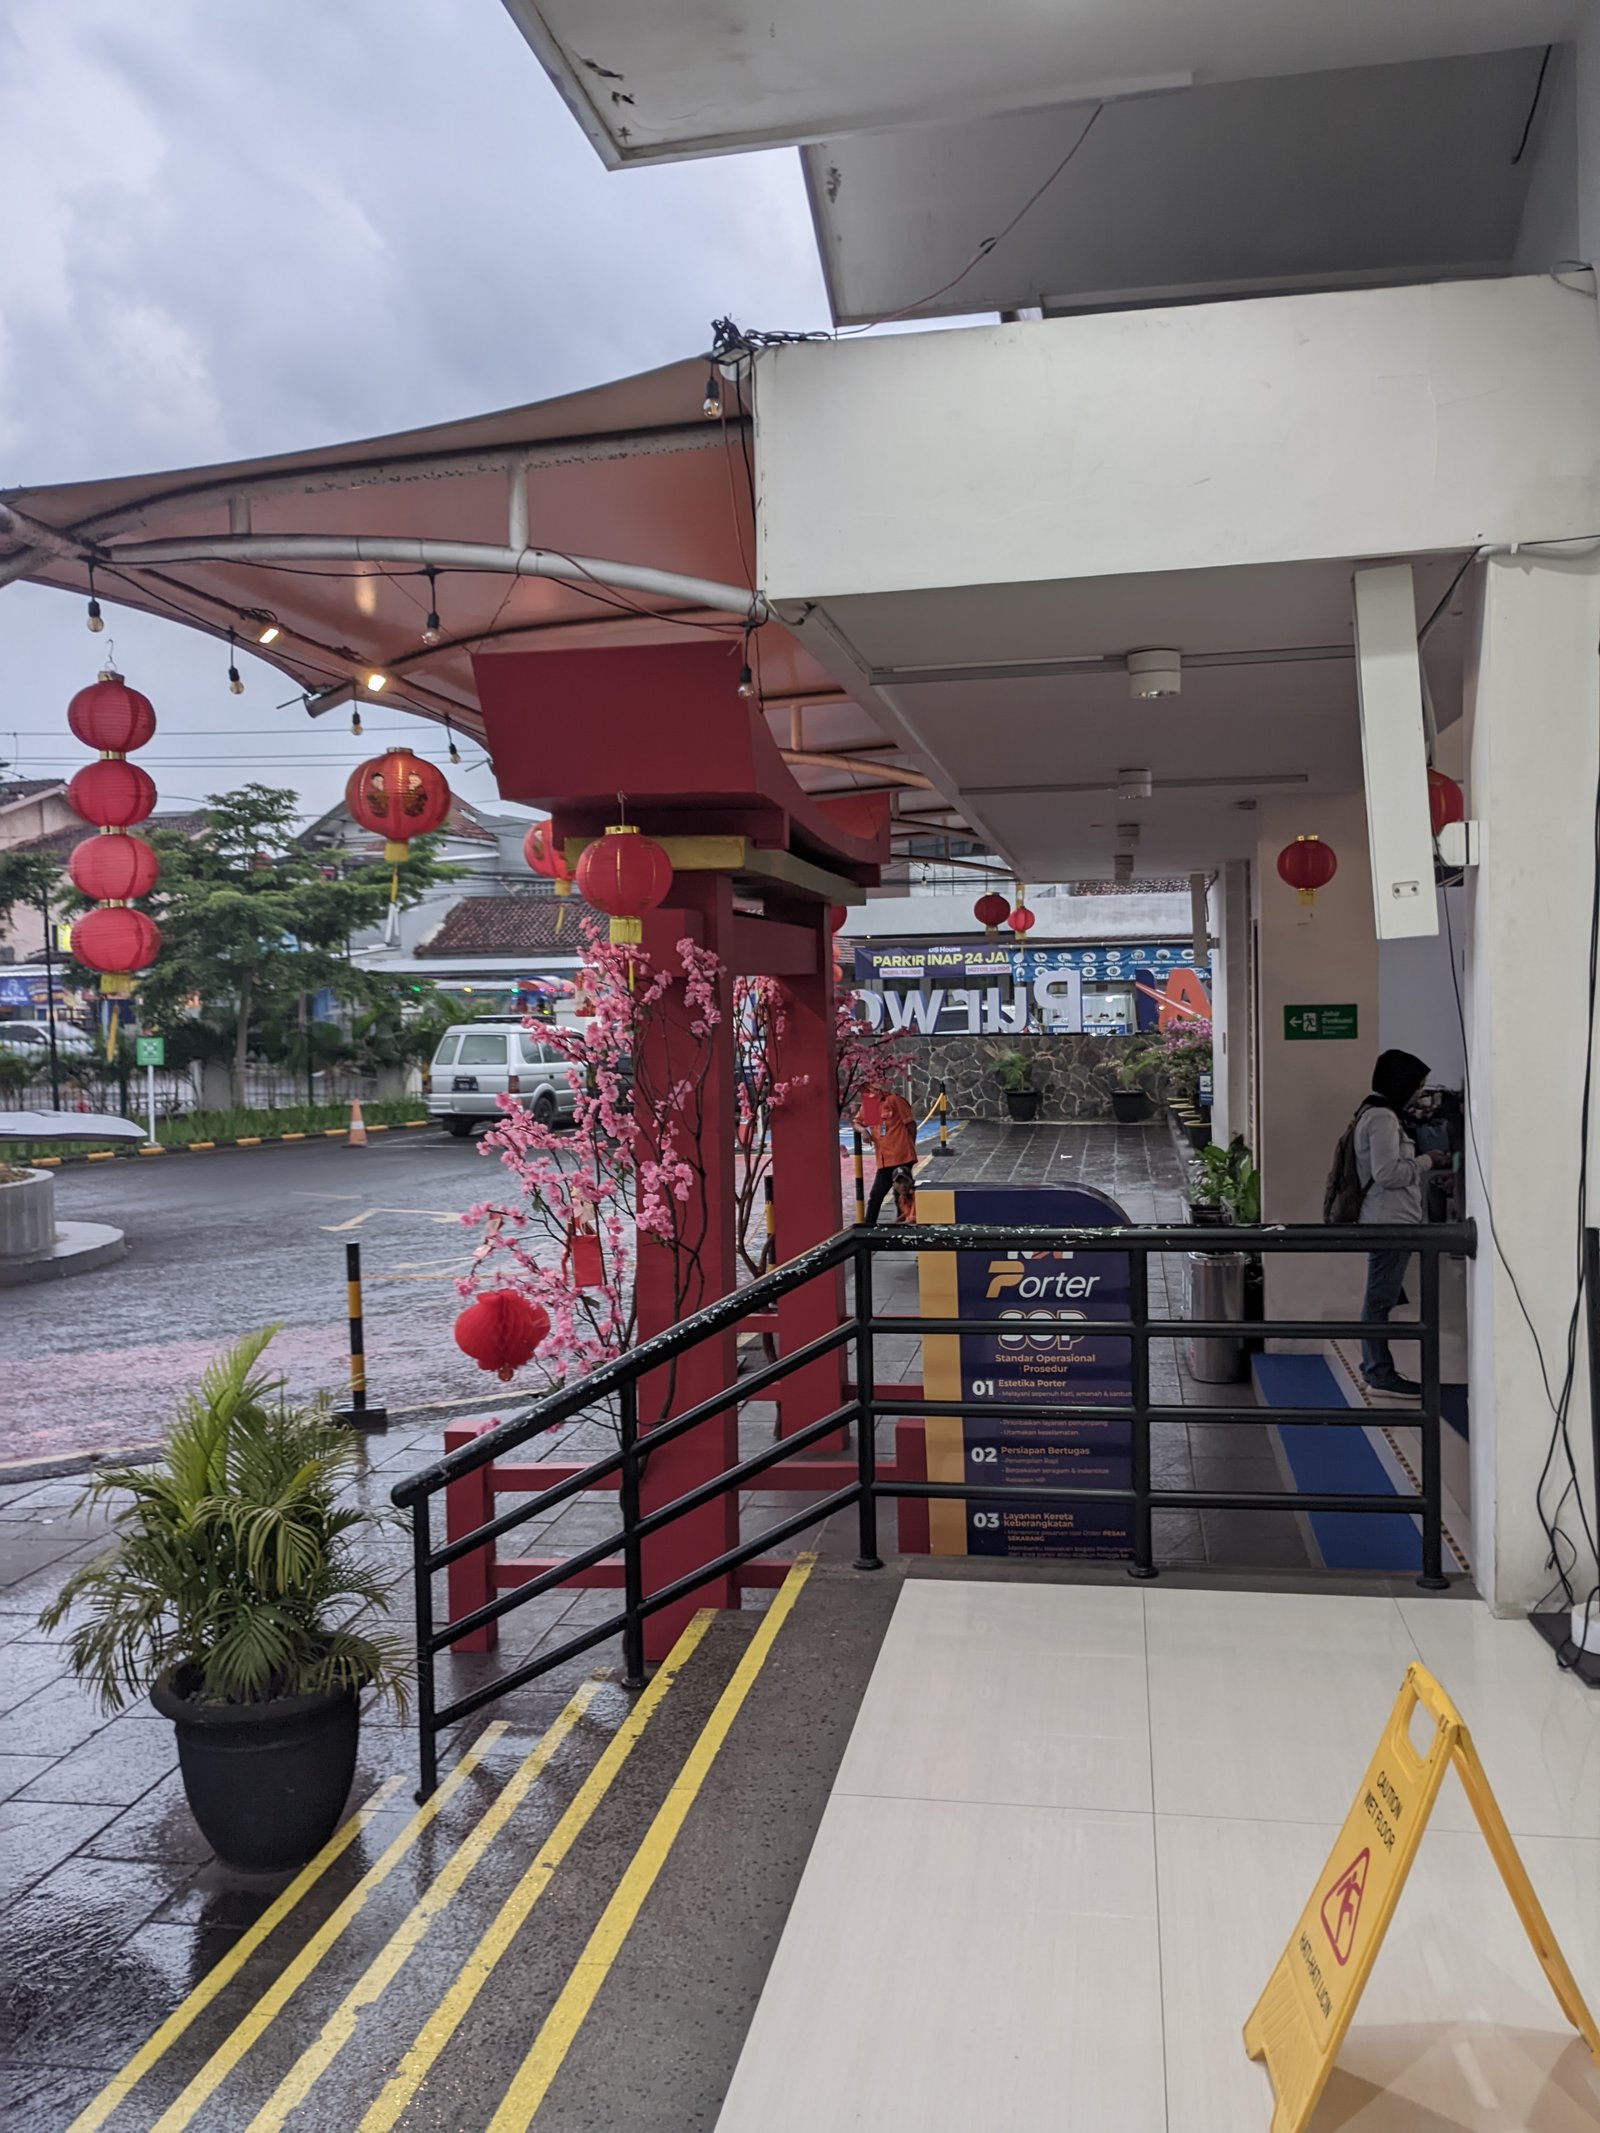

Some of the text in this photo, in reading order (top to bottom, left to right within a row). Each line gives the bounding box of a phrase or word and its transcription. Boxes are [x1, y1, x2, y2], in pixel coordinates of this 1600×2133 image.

[873, 955, 925, 967] PARKIR
[928, 953, 963, 966] INAP
[965, 952, 983, 964] 24
[985, 1260, 1101, 1298] Porter
[995, 1354, 1096, 1365] Standar Operasional
[1023, 1364, 1068, 1374] Prosedur
[972, 1380, 994, 1396] 01
[998, 1380, 1067, 1388] Estetika Porter
[971, 1447, 997, 1463] 02
[1001, 1447, 1090, 1456] Persiapan Bertugas
[973, 1512, 1000, 1528] 03
[1003, 1512, 1074, 1521] Layanan Kereta
[1003, 1520, 1074, 1528] Keberangkatan
[1377, 1771, 1403, 1821] CAUTION
[1364, 1789, 1396, 1854] WET FLOOR
[1299, 1930, 1322, 1990] HATI-HATI
